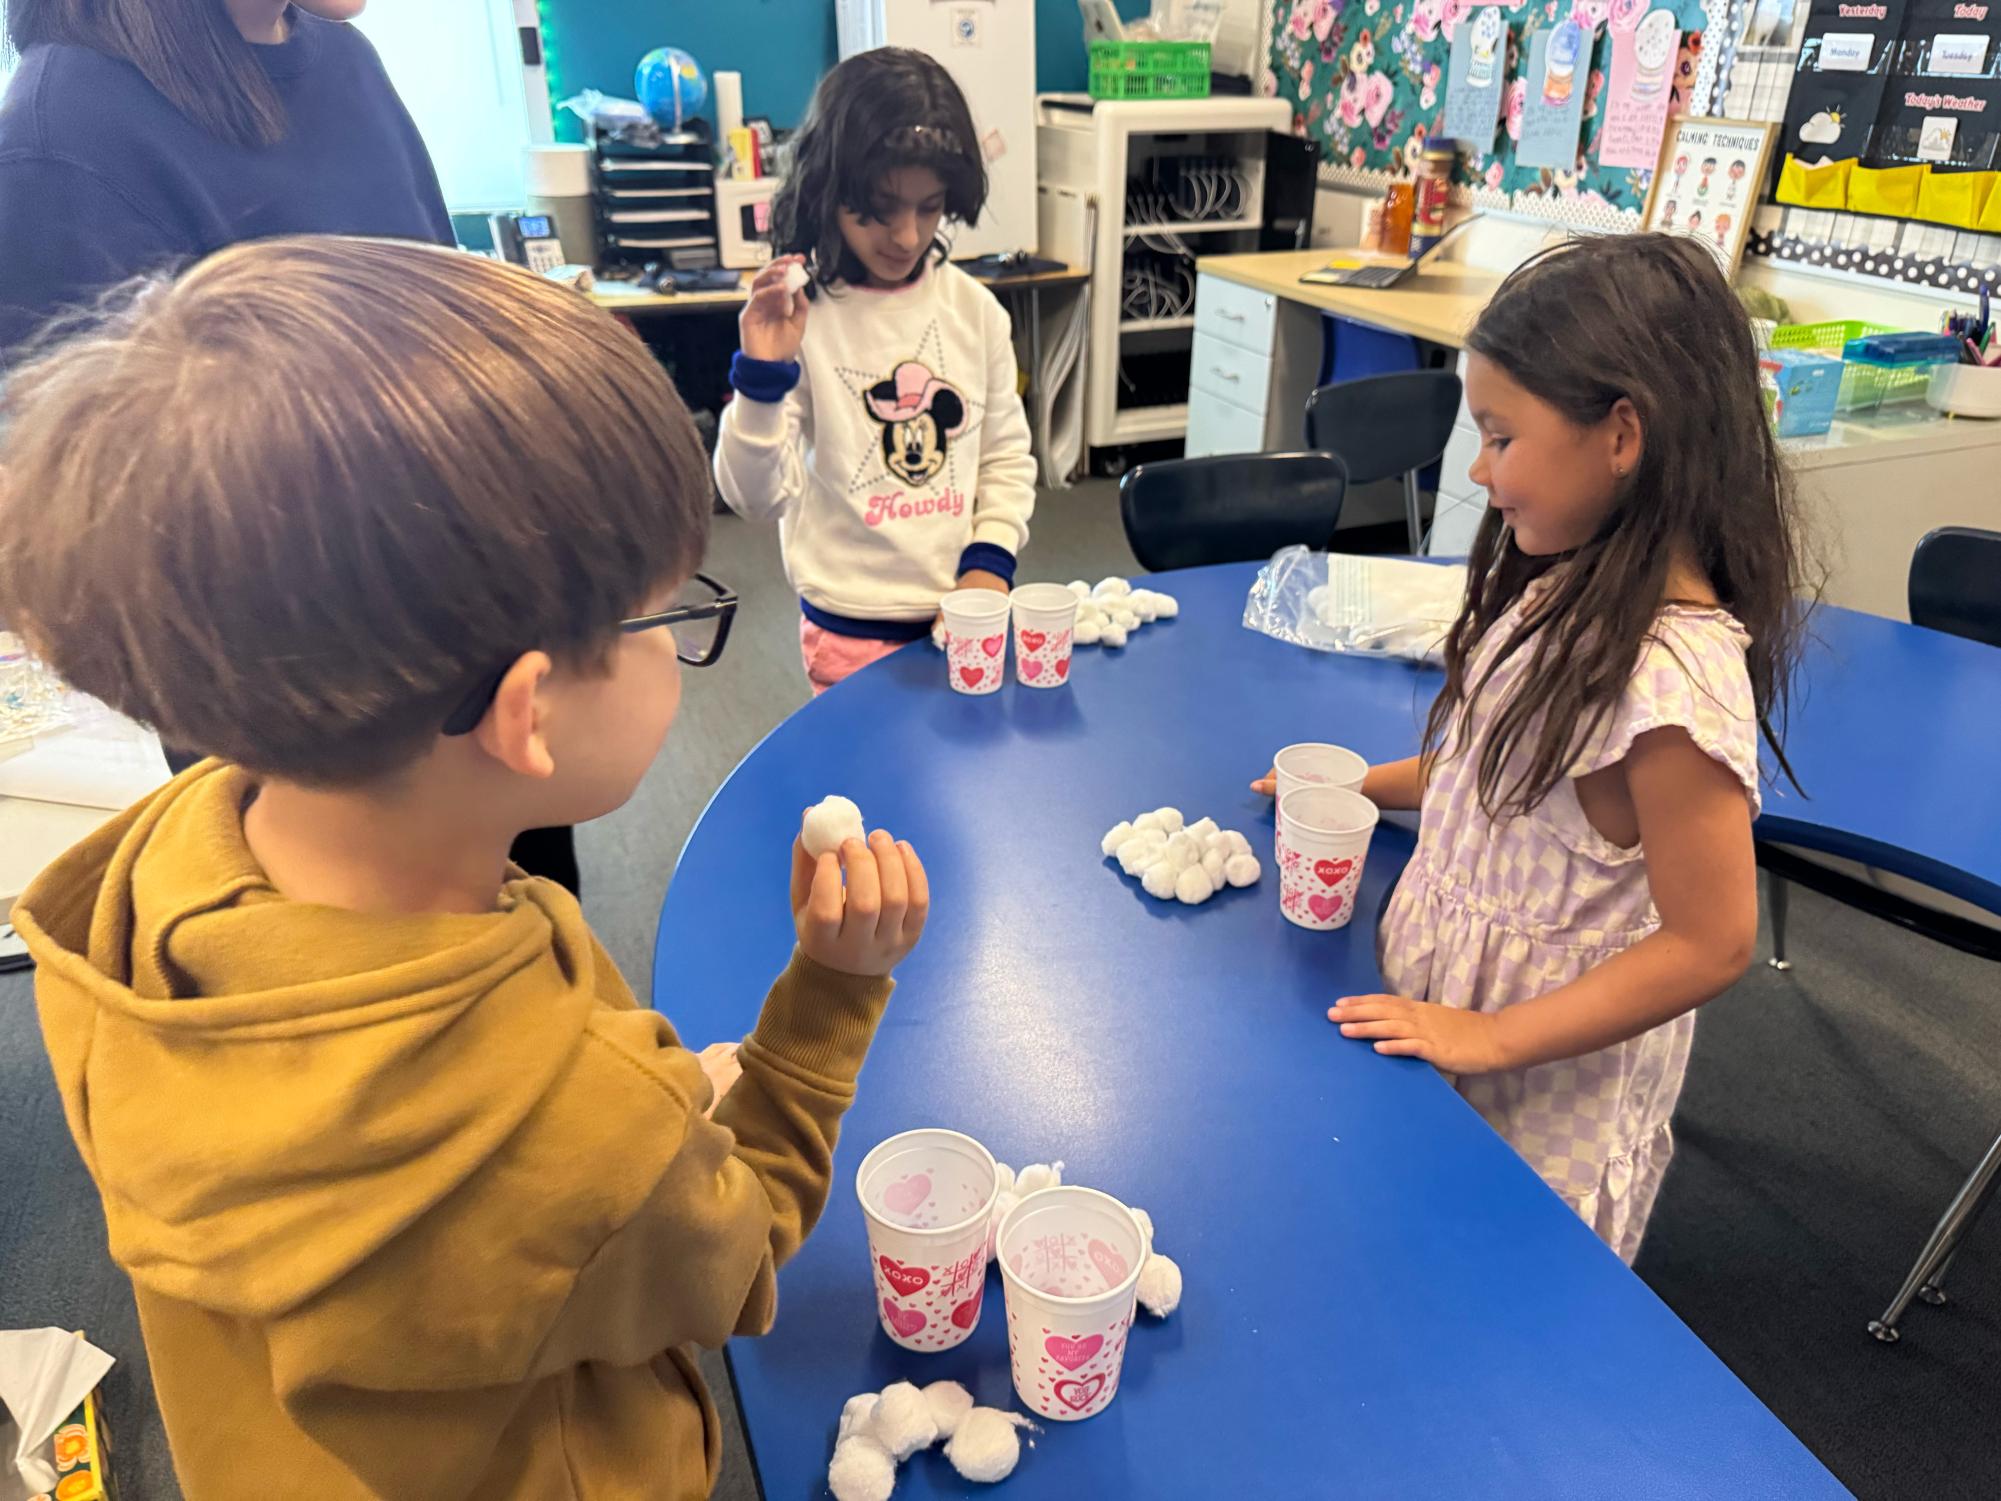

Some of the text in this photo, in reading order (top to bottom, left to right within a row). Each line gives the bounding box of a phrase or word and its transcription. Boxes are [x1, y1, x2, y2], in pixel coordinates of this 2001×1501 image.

[1839, 5, 1886, 19] Yesterday
[1954, 5, 1987, 20] Today
[1905, 93, 1986, 111] Today's Weather
[1676, 130, 1759, 151] CALMING TECHNIQUES
[865, 487, 964, 526] Howdy
[1318, 867, 1348, 875] XOXO
[884, 1264, 924, 1285] XOXO
